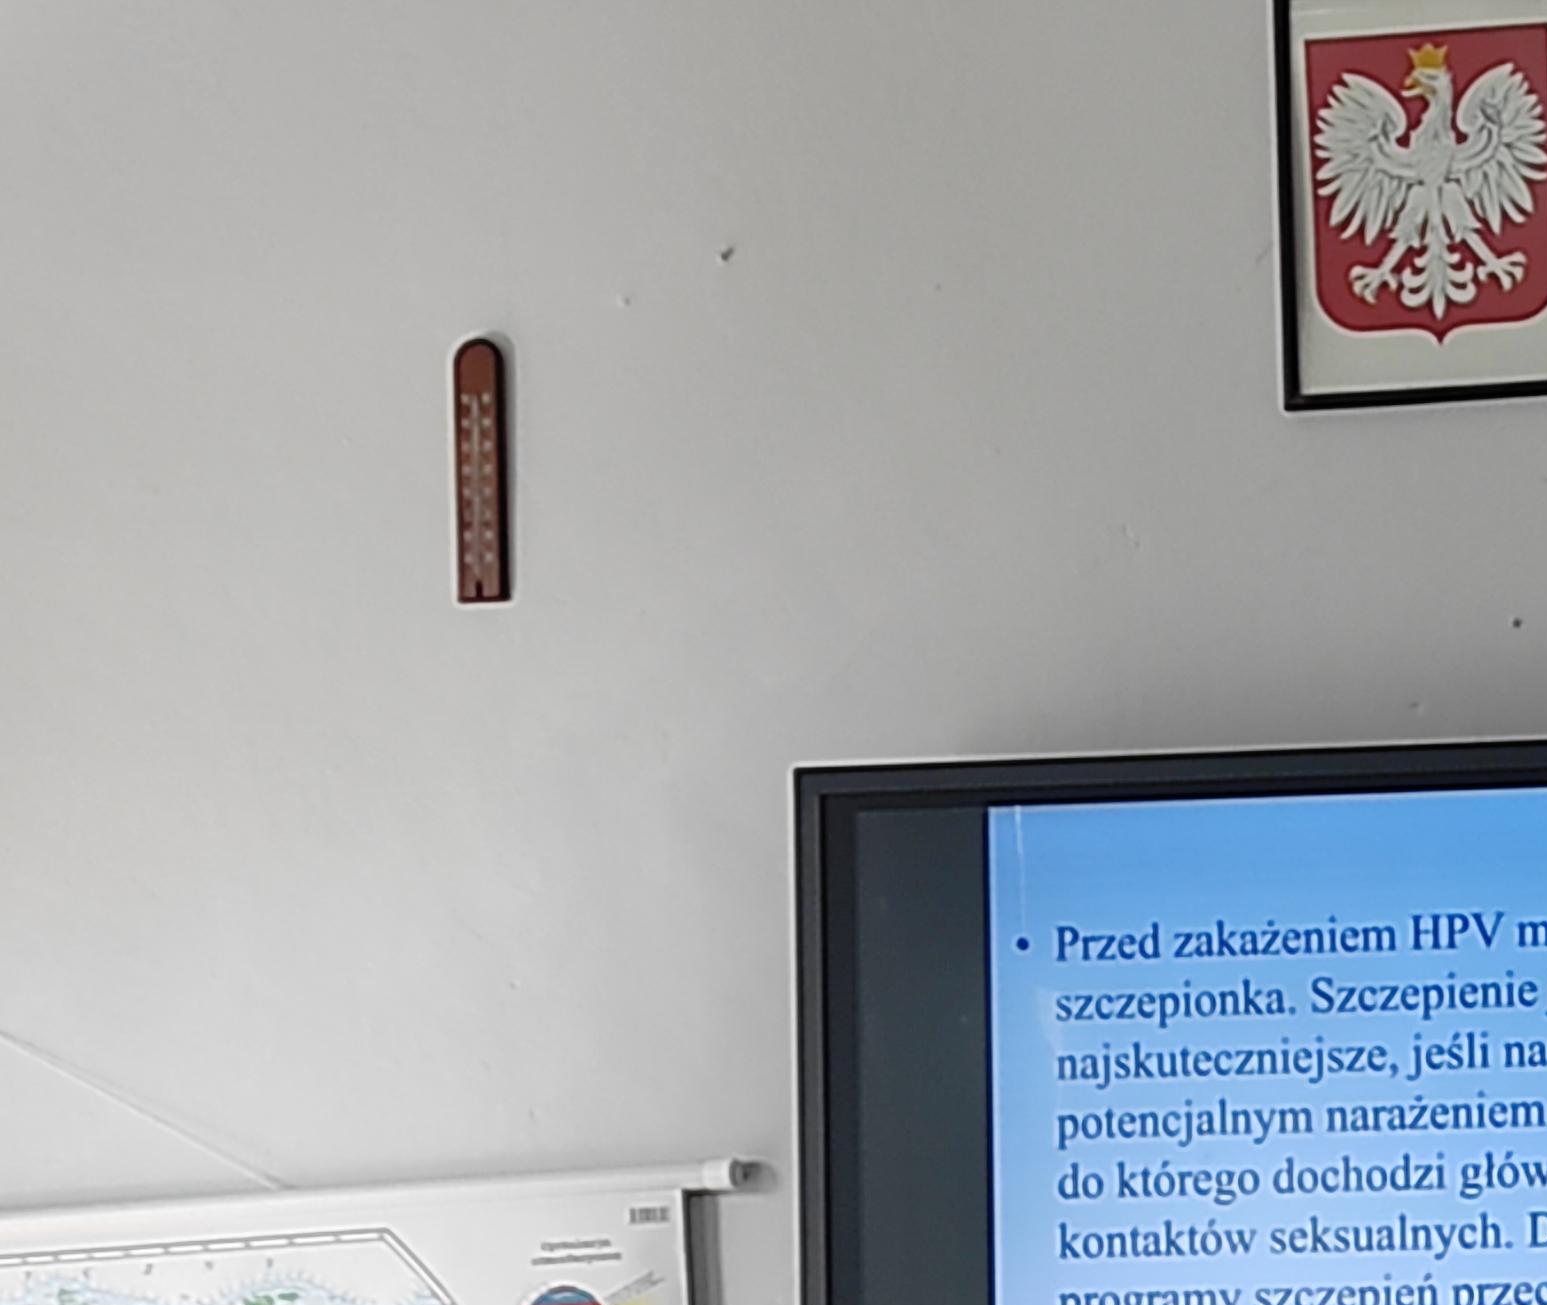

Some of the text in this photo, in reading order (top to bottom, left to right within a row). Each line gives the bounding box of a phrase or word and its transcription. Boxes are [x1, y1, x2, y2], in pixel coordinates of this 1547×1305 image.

[1055, 920, 1162, 963] Przed
[1172, 914, 1398, 959] zakażeniem
[1410, 909, 1506, 952] HPV
[1055, 977, 1298, 1030] szczepionka.
[1310, 968, 1540, 1022] Szczepienie
[1056, 1034, 1400, 1091] najskuteczniejsze,
[1404, 1029, 1491, 1083] jeśli
[1056, 1096, 1315, 1152] potencjalnym
[1325, 1089, 1547, 1134] narażeniem
[1056, 1160, 1106, 1201] do
[1115, 1158, 1261, 1207] którego
[1271, 1150, 1447, 1195] dochodzi
[1057, 1217, 1258, 1261] kontaktów
[1269, 1210, 1515, 1262] seksualnych.
